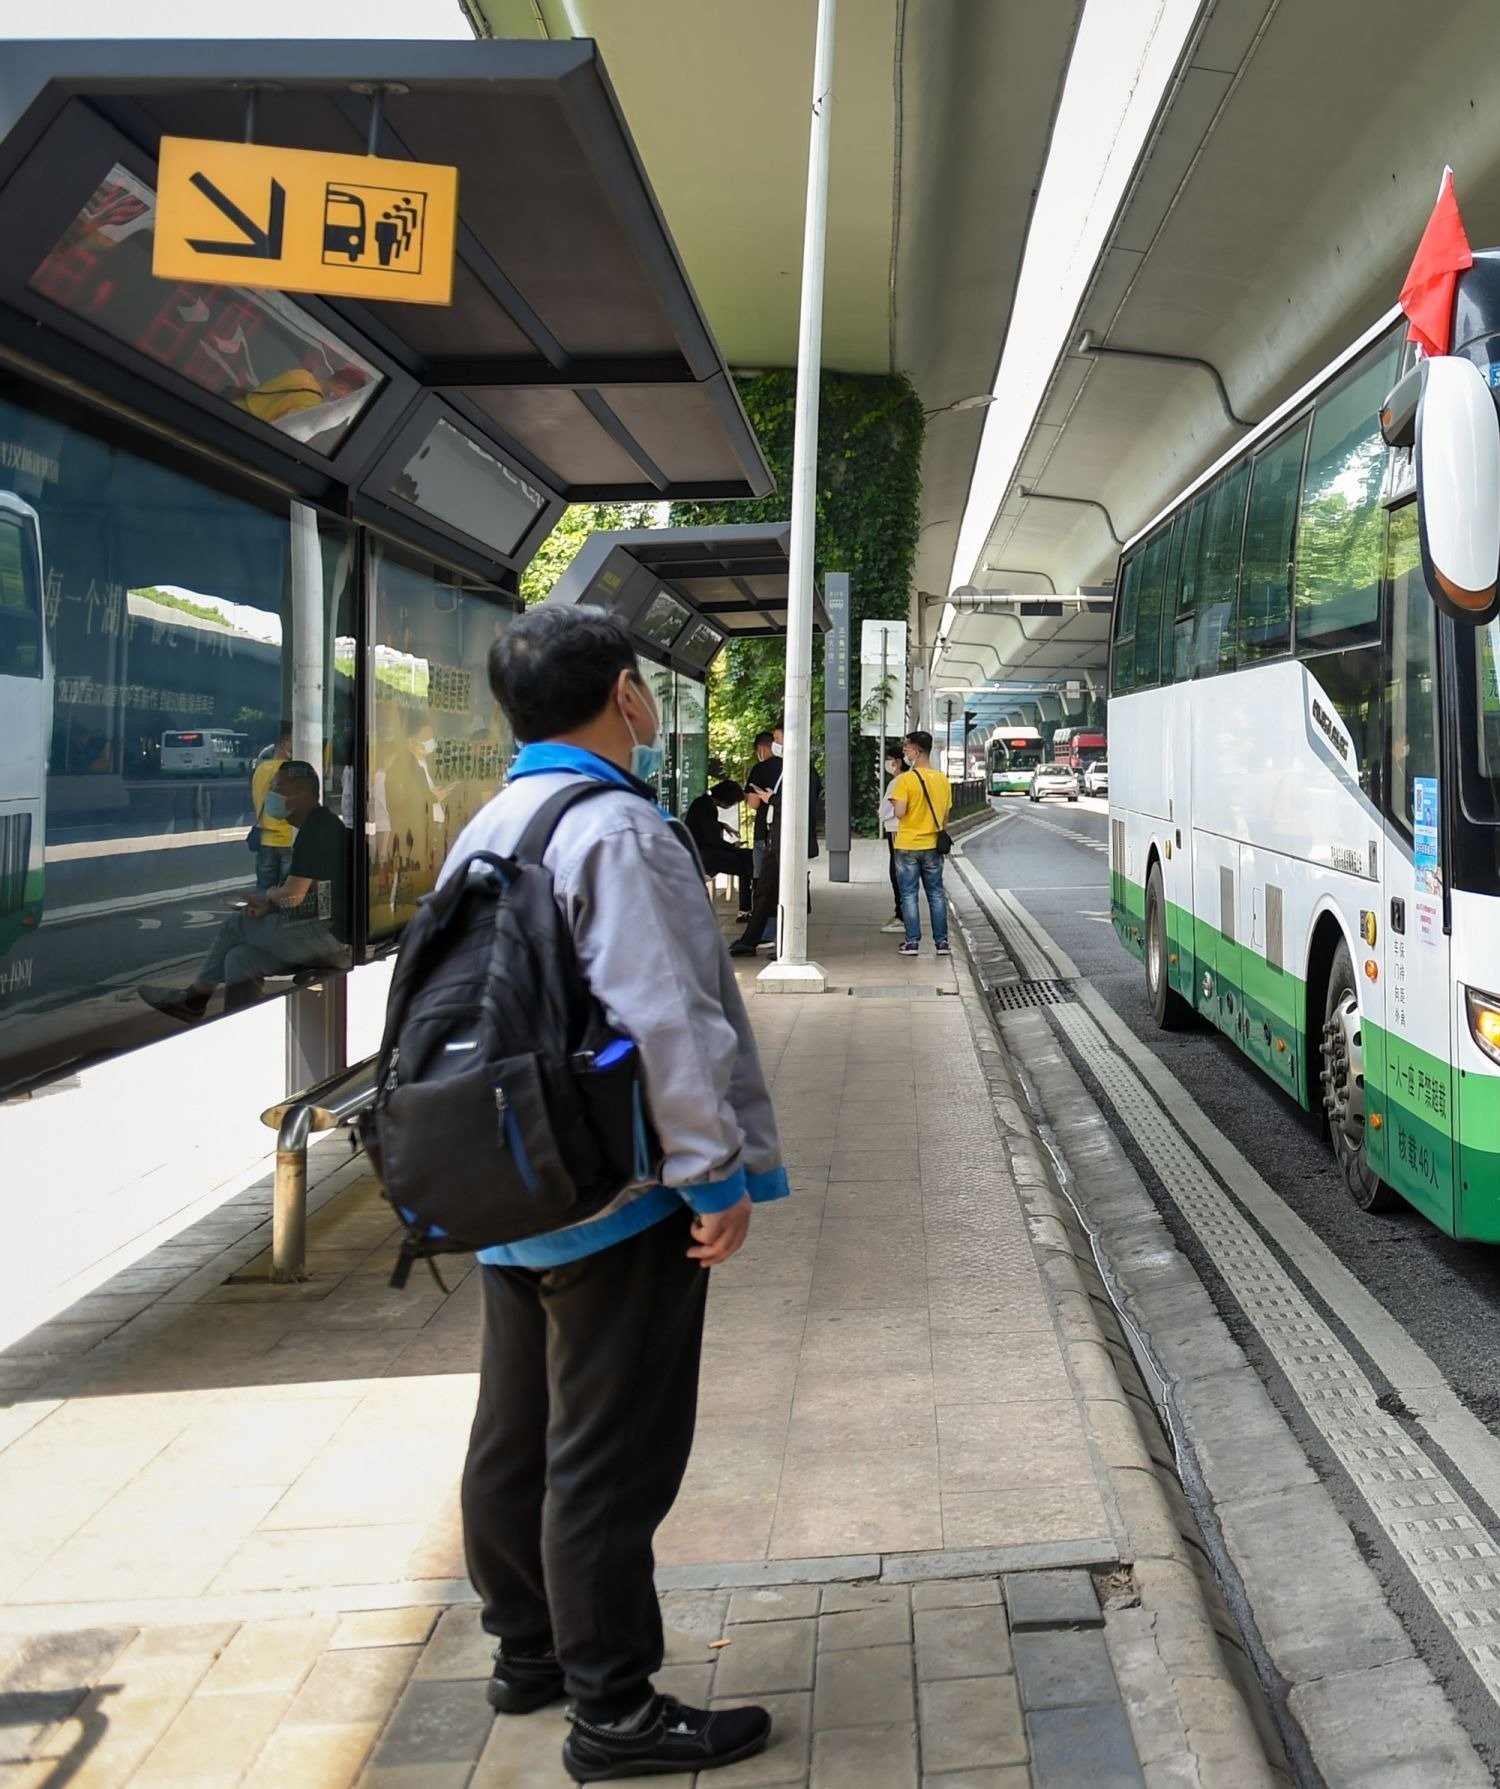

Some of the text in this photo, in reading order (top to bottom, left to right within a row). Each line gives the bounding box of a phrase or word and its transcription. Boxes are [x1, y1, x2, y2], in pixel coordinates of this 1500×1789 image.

[1389, 1055, 1415, 1097] 一人一座
[1397, 1126, 1440, 1190] 核载46人
